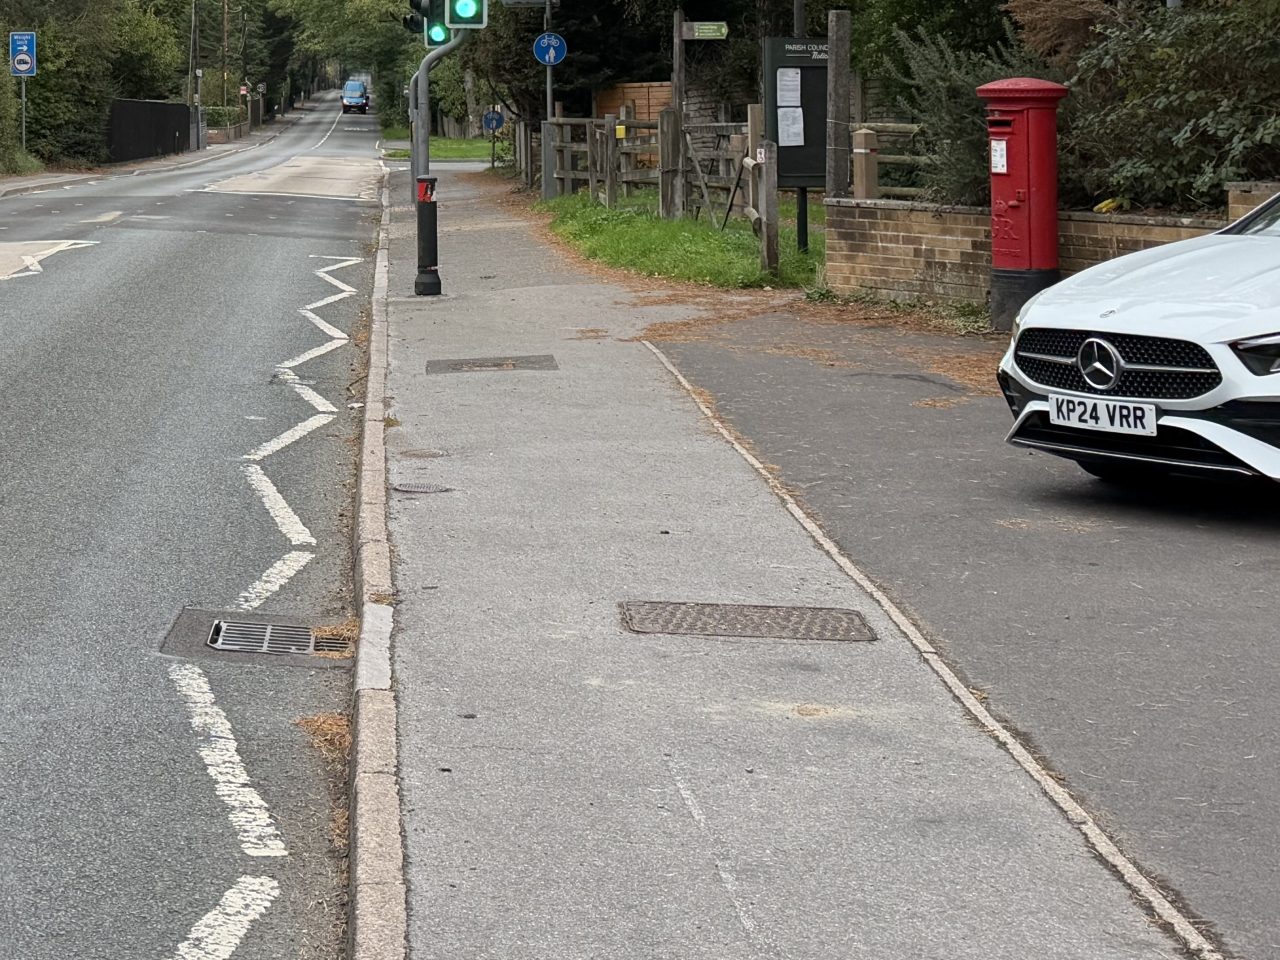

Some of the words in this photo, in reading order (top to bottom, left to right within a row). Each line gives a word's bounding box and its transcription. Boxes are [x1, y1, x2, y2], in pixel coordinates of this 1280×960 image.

[812, 51, 829, 59] Notic
[1056, 397, 1100, 425] KP24
[1106, 403, 1147, 430] VRR
